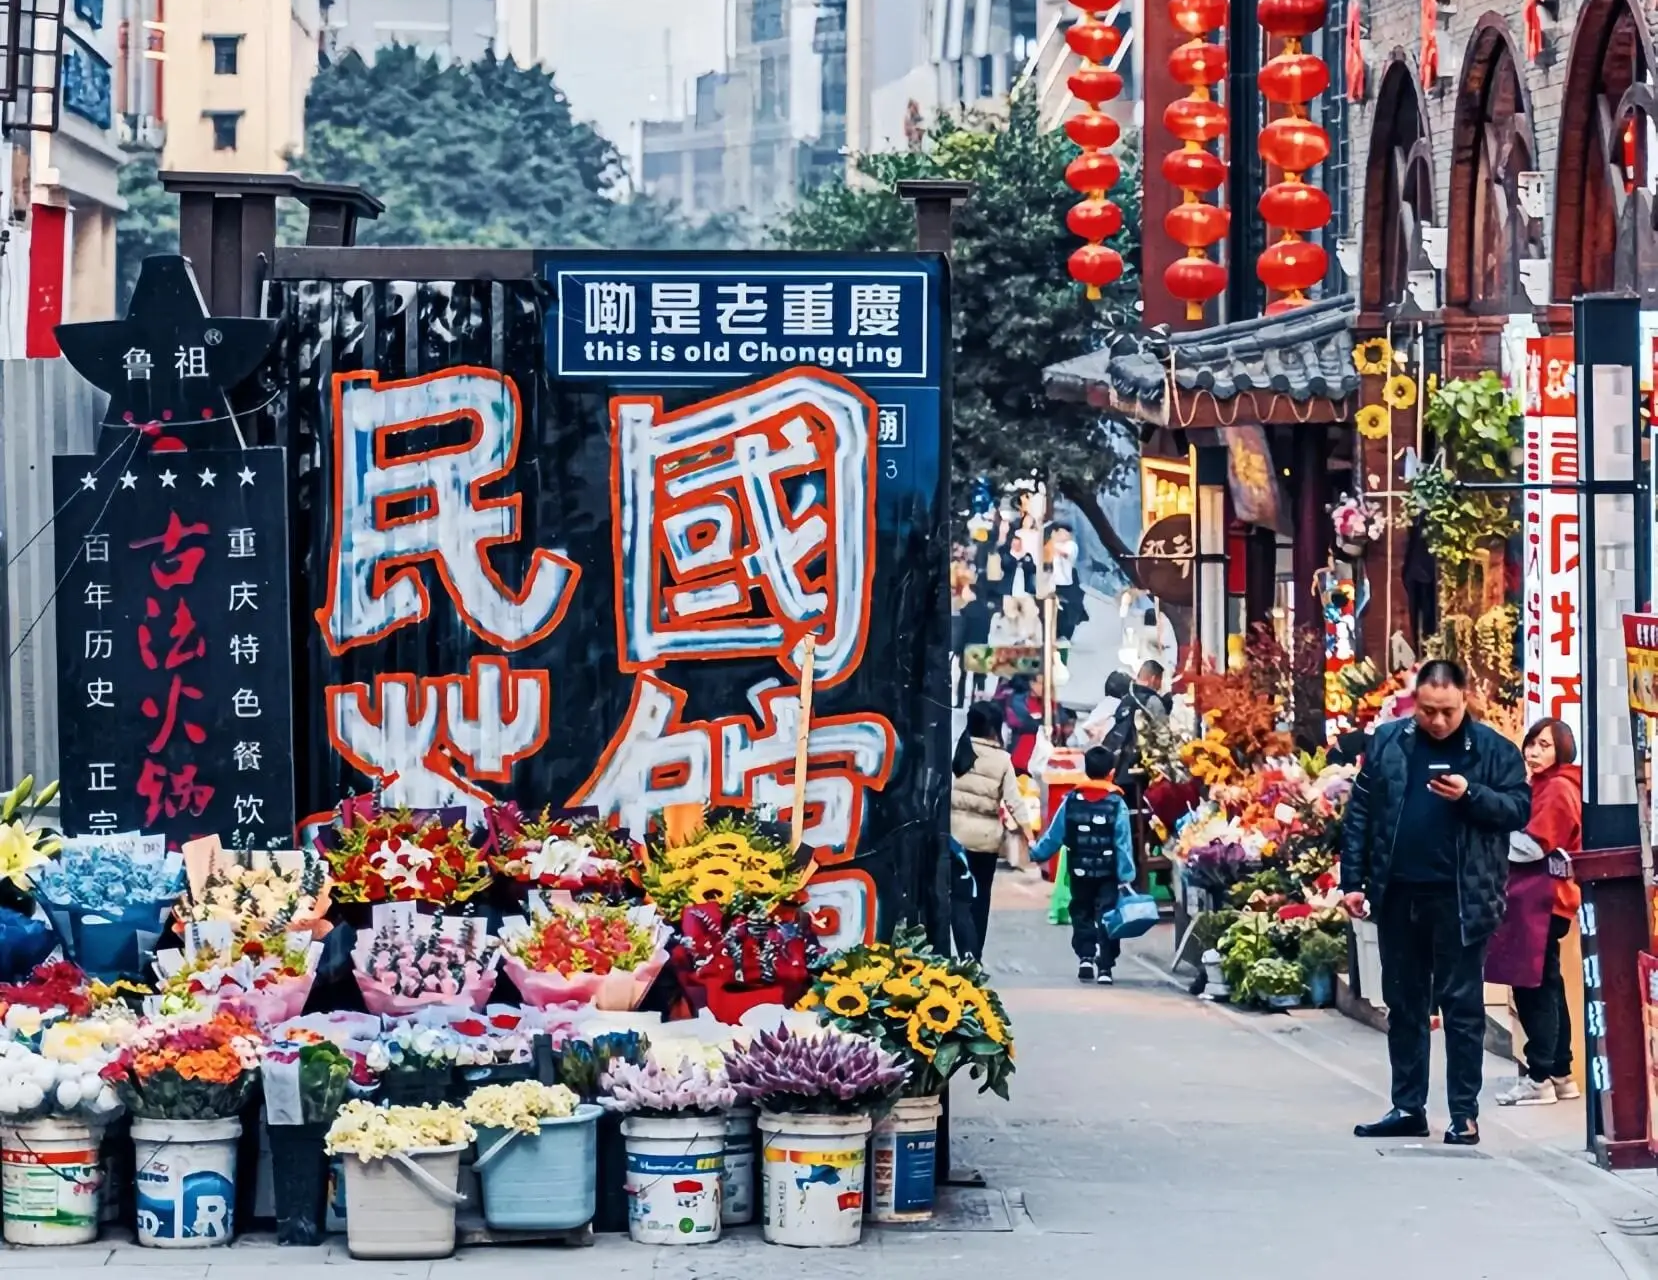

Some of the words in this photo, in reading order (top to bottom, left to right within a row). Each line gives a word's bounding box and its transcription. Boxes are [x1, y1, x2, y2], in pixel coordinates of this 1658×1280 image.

[122, 344, 210, 381] 鲁祖
[584, 341, 642, 362] this
[650, 341, 676, 362] is
[684, 341, 730, 362] old
[738, 341, 903, 368] Chongqing
[315, 364, 880, 690] 民國
[83, 533, 116, 709] 百年历史
[128, 509, 216, 852] 古法火锅
[227, 528, 265, 825] 重庆特色餐饮
[87, 762, 119, 836] 正宗
